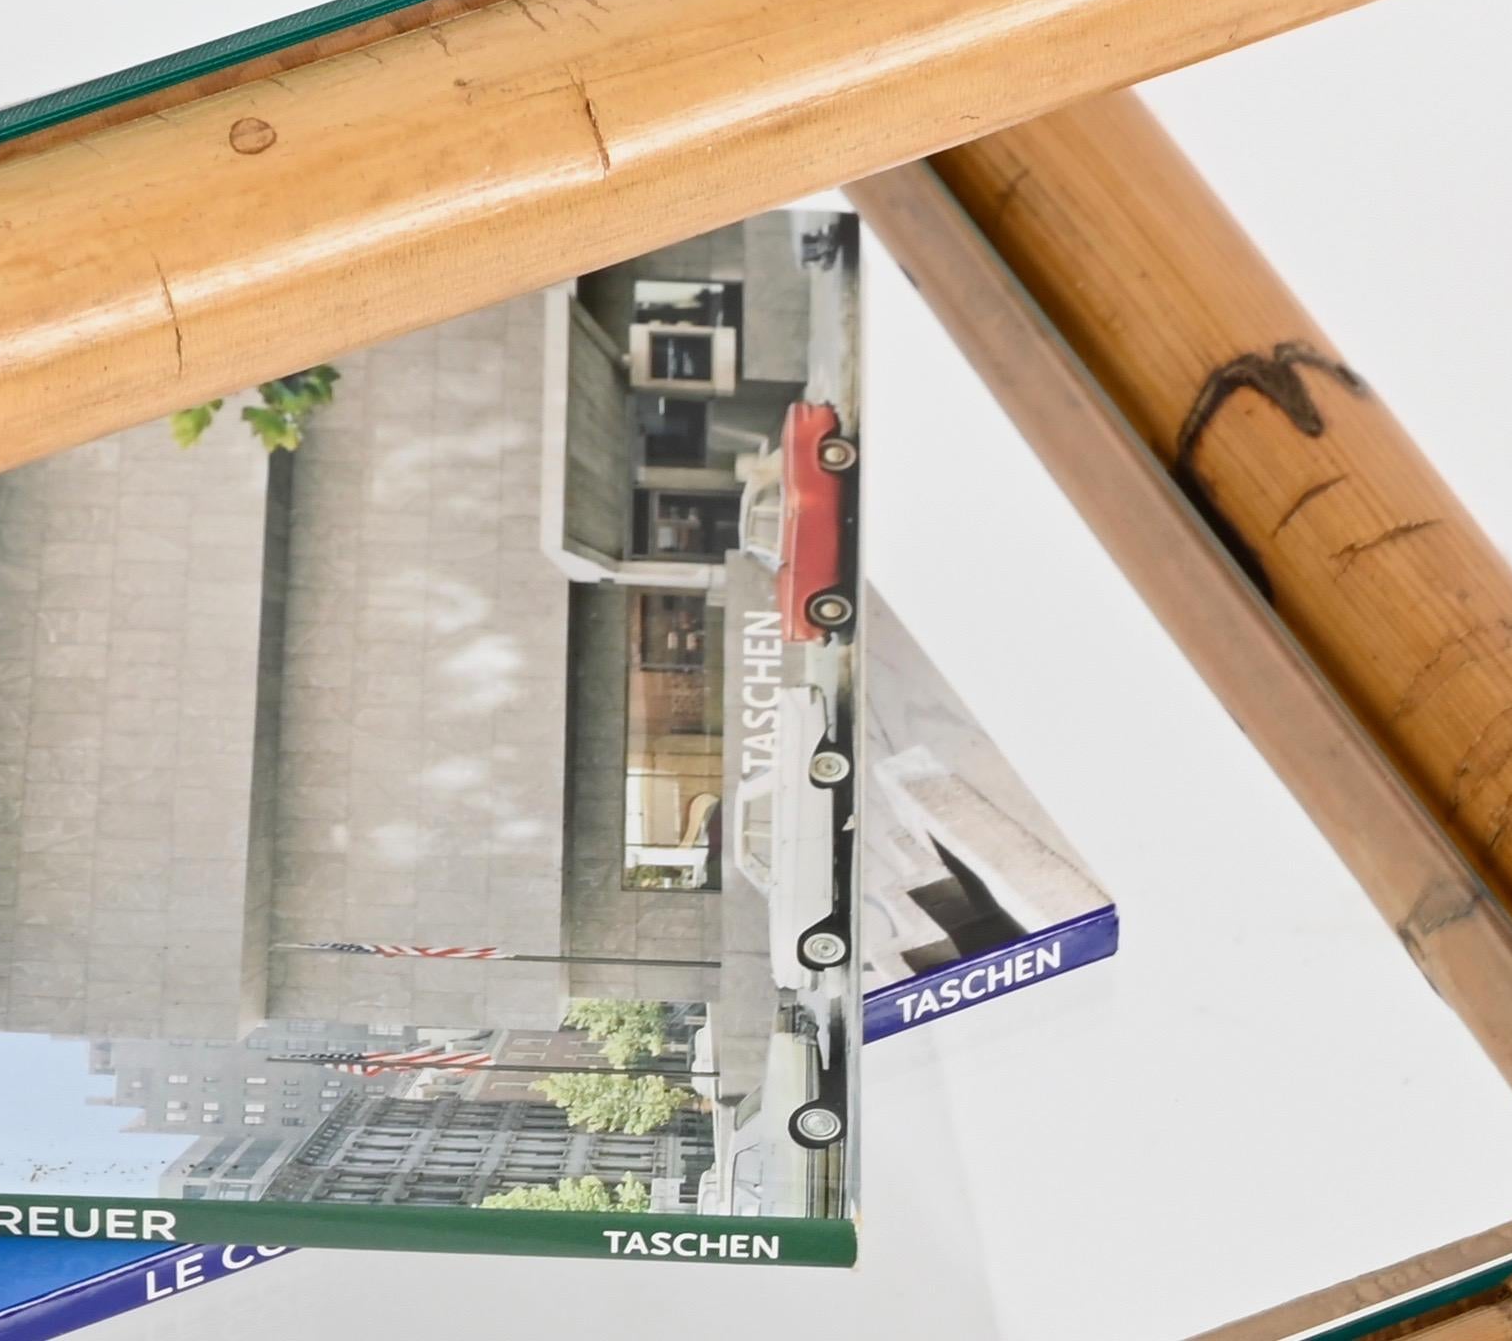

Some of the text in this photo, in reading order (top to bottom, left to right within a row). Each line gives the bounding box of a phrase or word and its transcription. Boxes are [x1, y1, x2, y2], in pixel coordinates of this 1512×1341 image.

[742, 611, 783, 774] TASCHEN
[896, 941, 1061, 1023] TASCHEN
[145, 1252, 206, 1302] LE
[602, 1230, 780, 1260] TASCHEN
